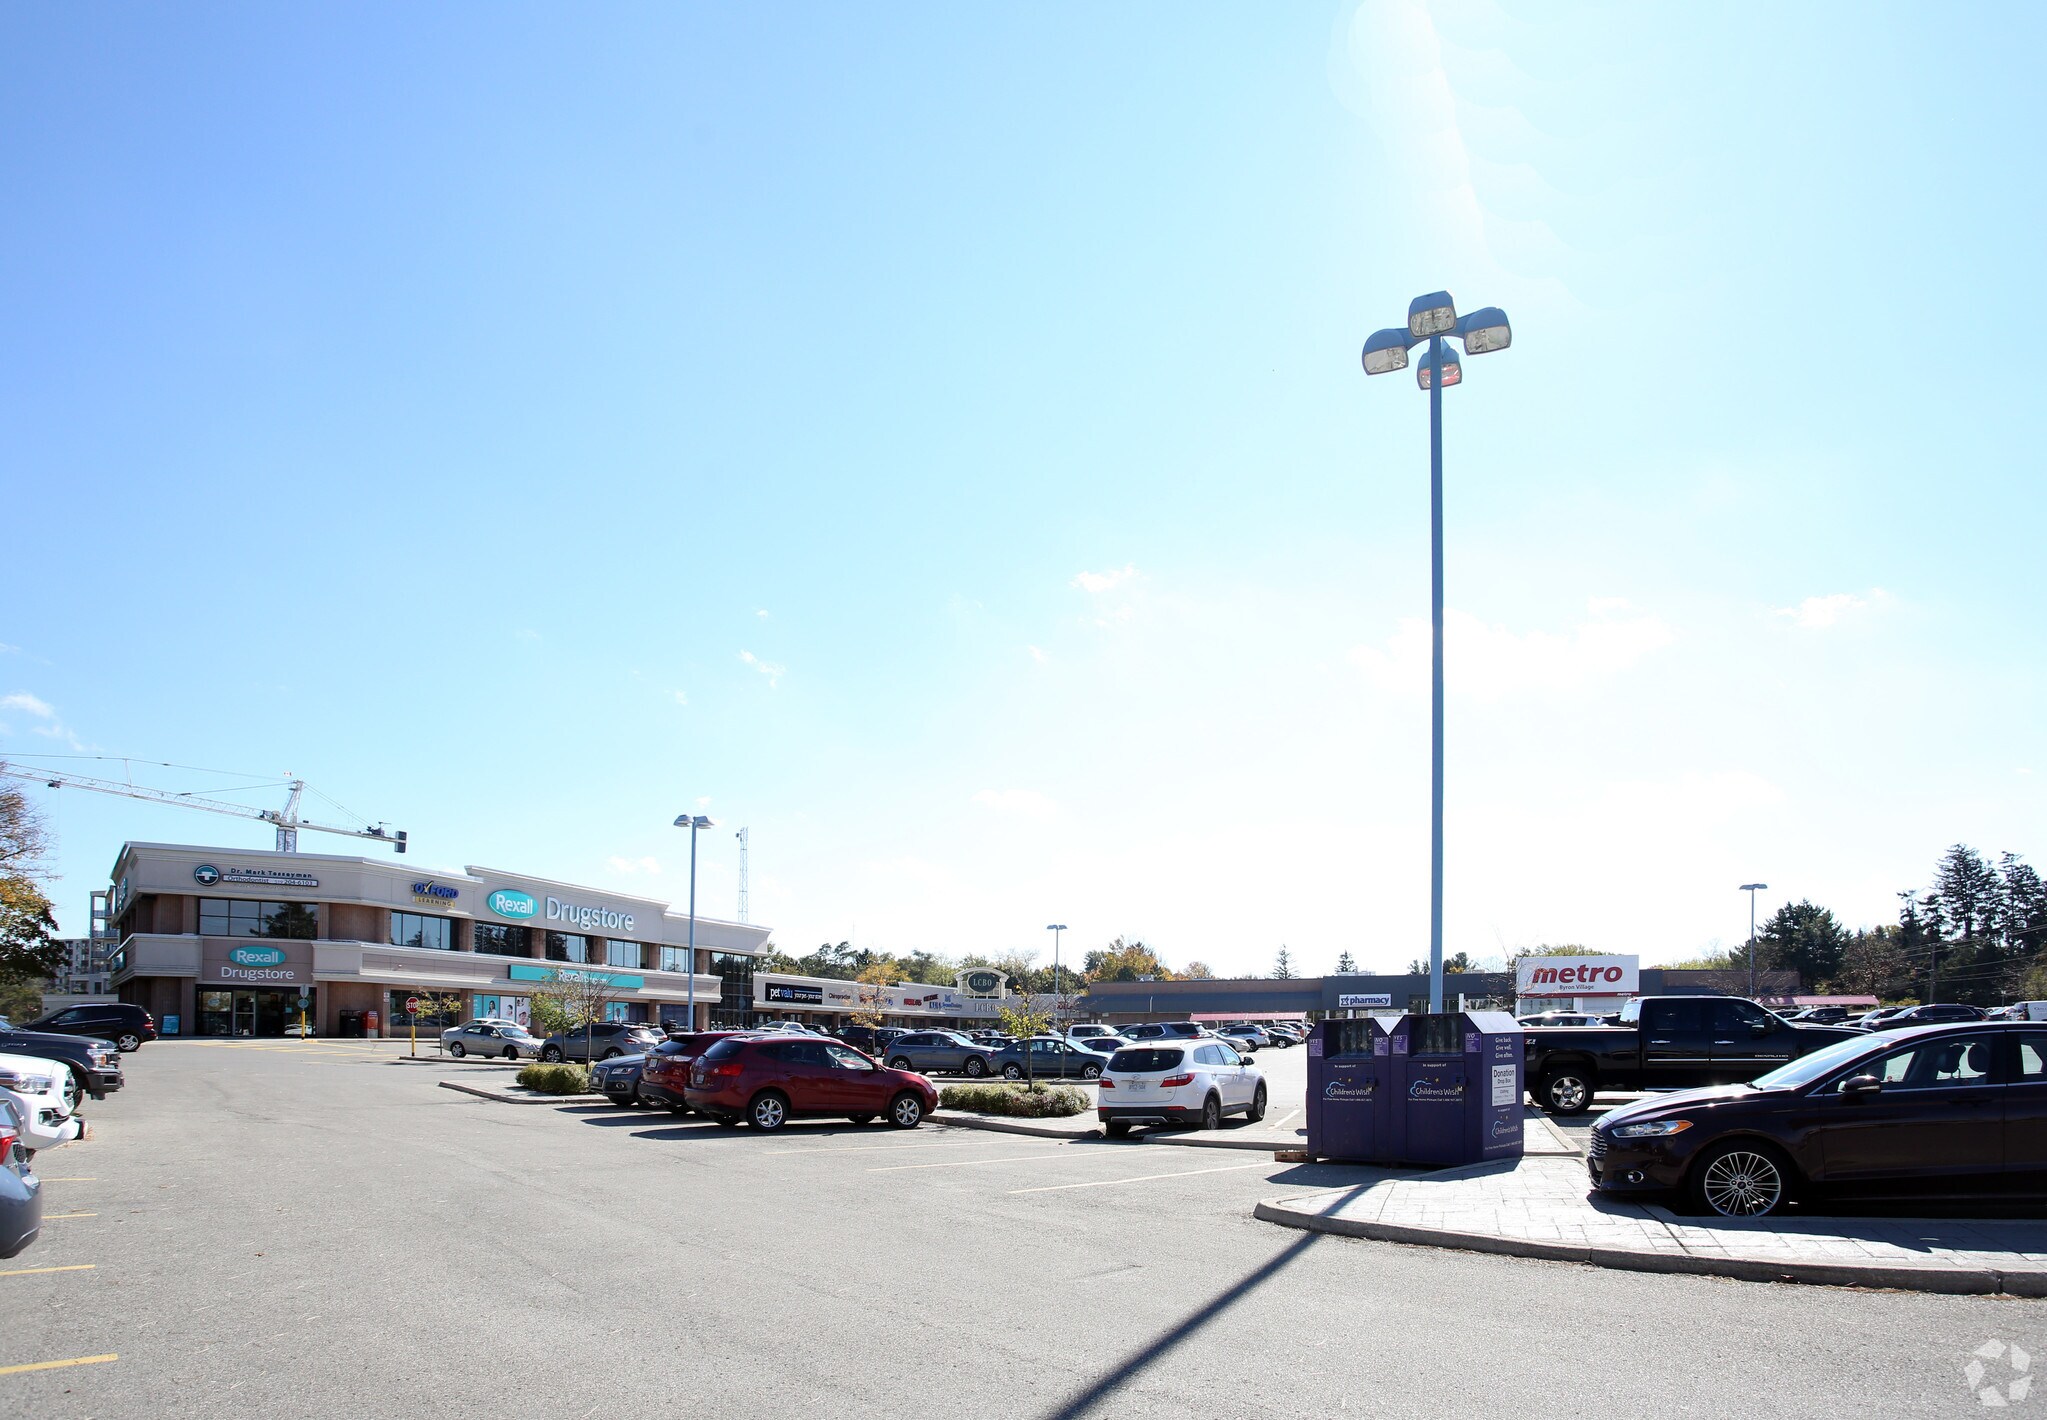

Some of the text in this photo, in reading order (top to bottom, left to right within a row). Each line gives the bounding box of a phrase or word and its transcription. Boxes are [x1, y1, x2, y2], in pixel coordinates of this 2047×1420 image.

[227, 874, 269, 883] Orthodontist
[414, 881, 459, 899] OXFORD
[418, 897, 452, 907] LEARNING
[496, 894, 634, 932] Rexall Drugstore
[236, 950, 279, 963] Rexall
[221, 966, 295, 981] Drugstore
[559, 968, 584, 982] Rexall
[1532, 964, 1623, 984] metro
[973, 978, 992, 986] LCBO
[770, 987, 793, 1000] pet valu
[1350, 996, 1390, 1006] pharmacy
[975, 1003, 997, 1012] LCBO
[1494, 1069, 1514, 1077] Donation
[1330, 1088, 1355, 1096] Children's
[1415, 1087, 1443, 1095] Children's
